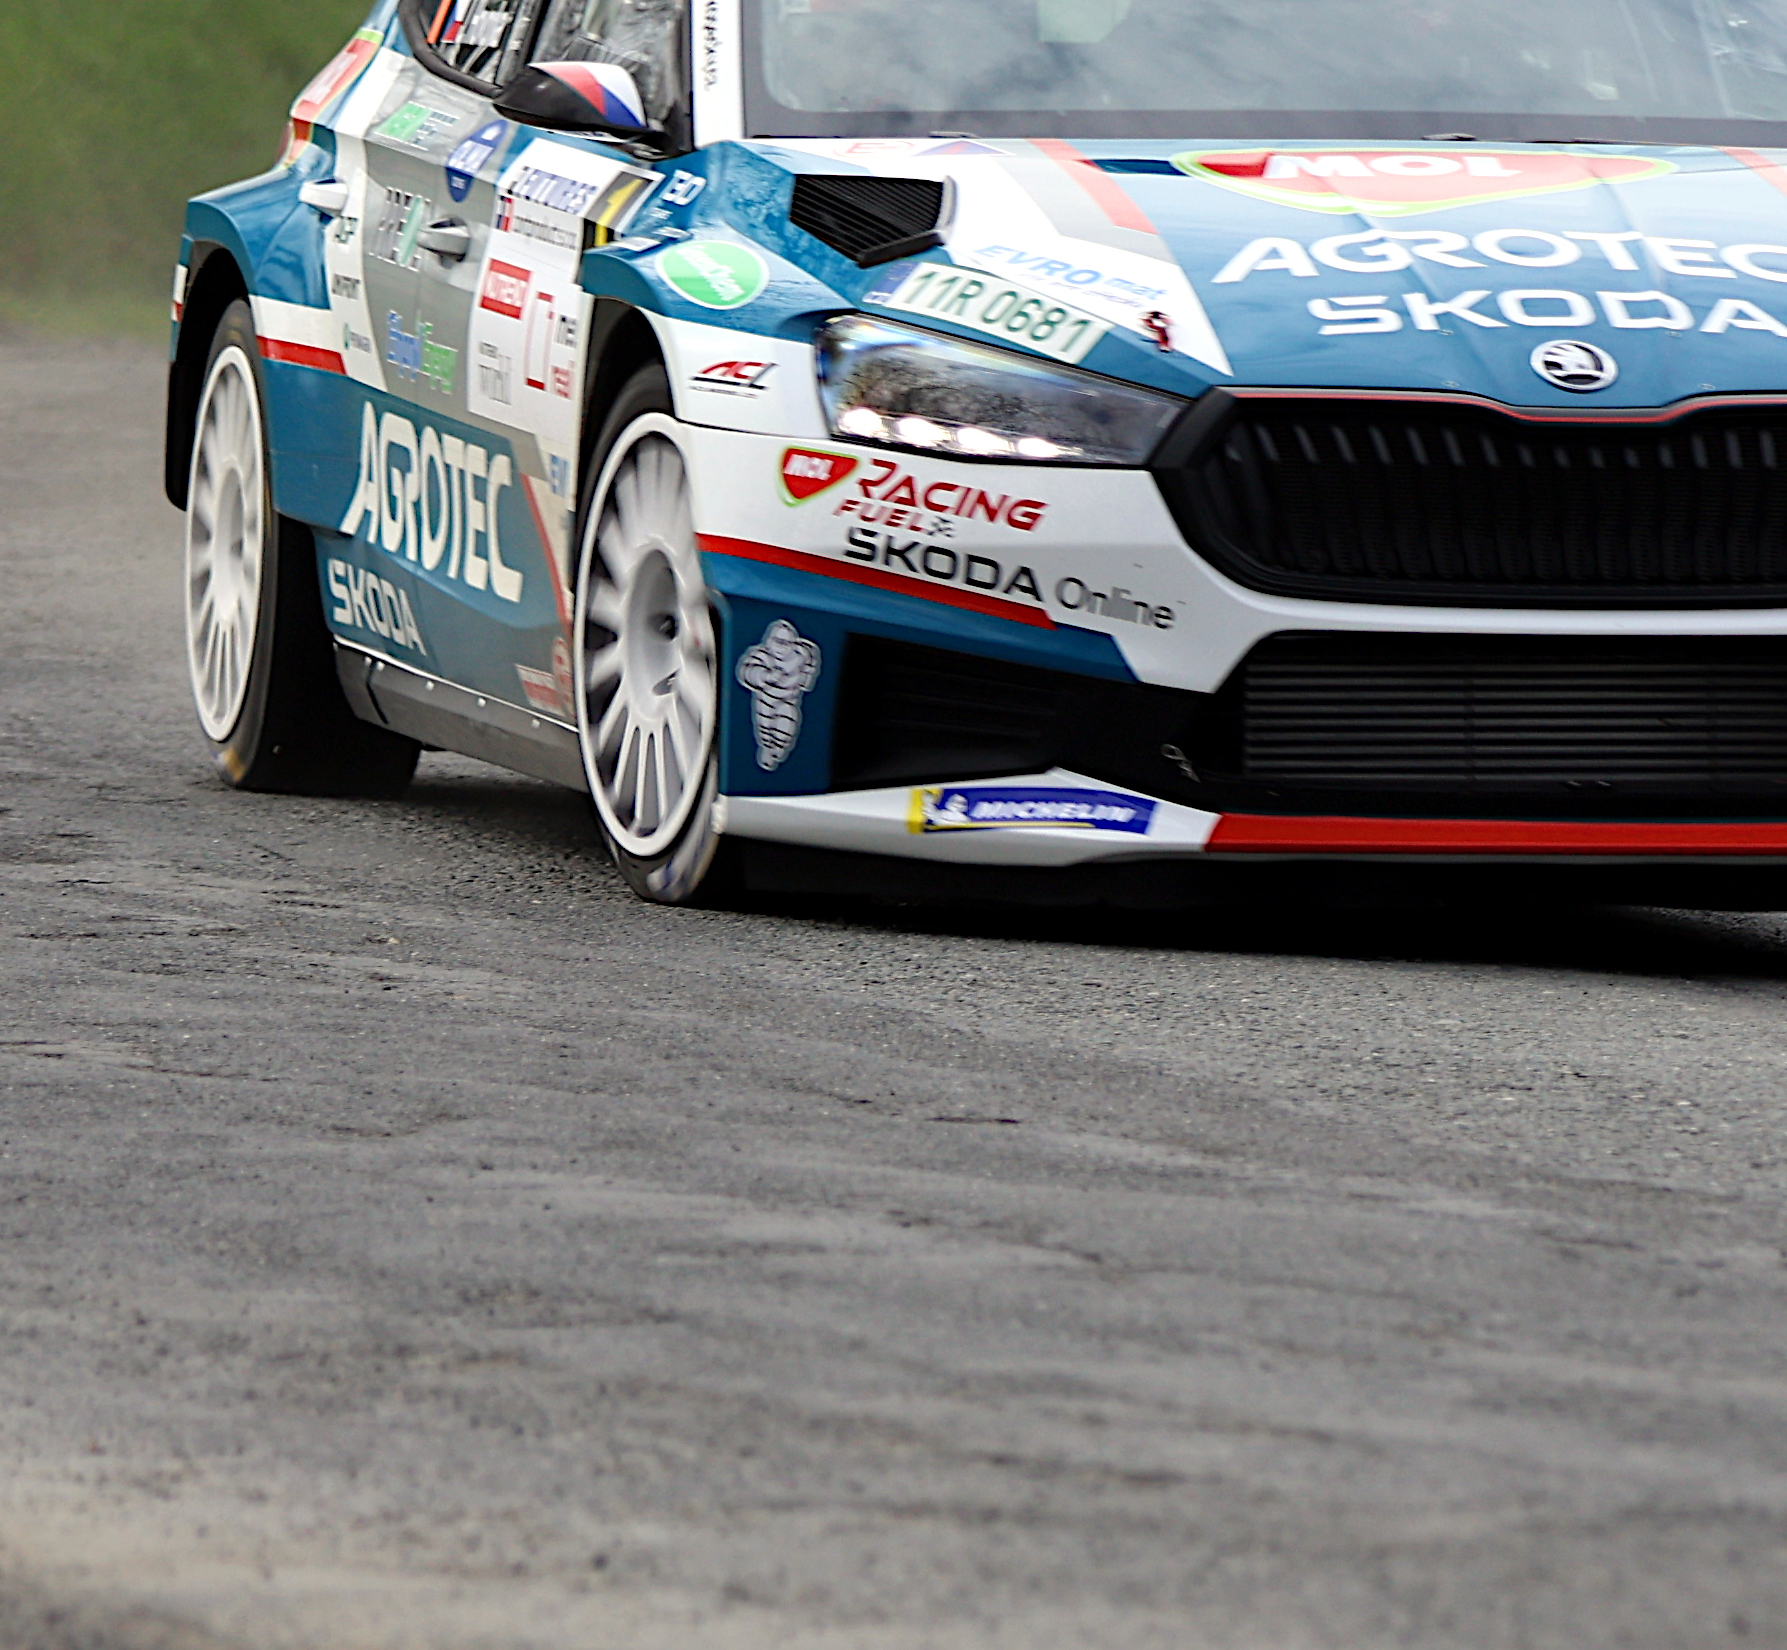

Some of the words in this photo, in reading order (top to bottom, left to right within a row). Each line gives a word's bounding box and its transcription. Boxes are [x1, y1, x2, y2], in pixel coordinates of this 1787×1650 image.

[1263, 154, 1523, 180] MOL
[975, 245, 1103, 286] EVRO
[903, 270, 984, 313] 11R
[982, 290, 1094, 354] 0681
[340, 401, 524, 603] AGROTEC
[782, 453, 835, 481] MOL
[855, 458, 1050, 532] RACING
[1054, 576, 1178, 631] Online
[969, 801, 1137, 823] MICHELIN
